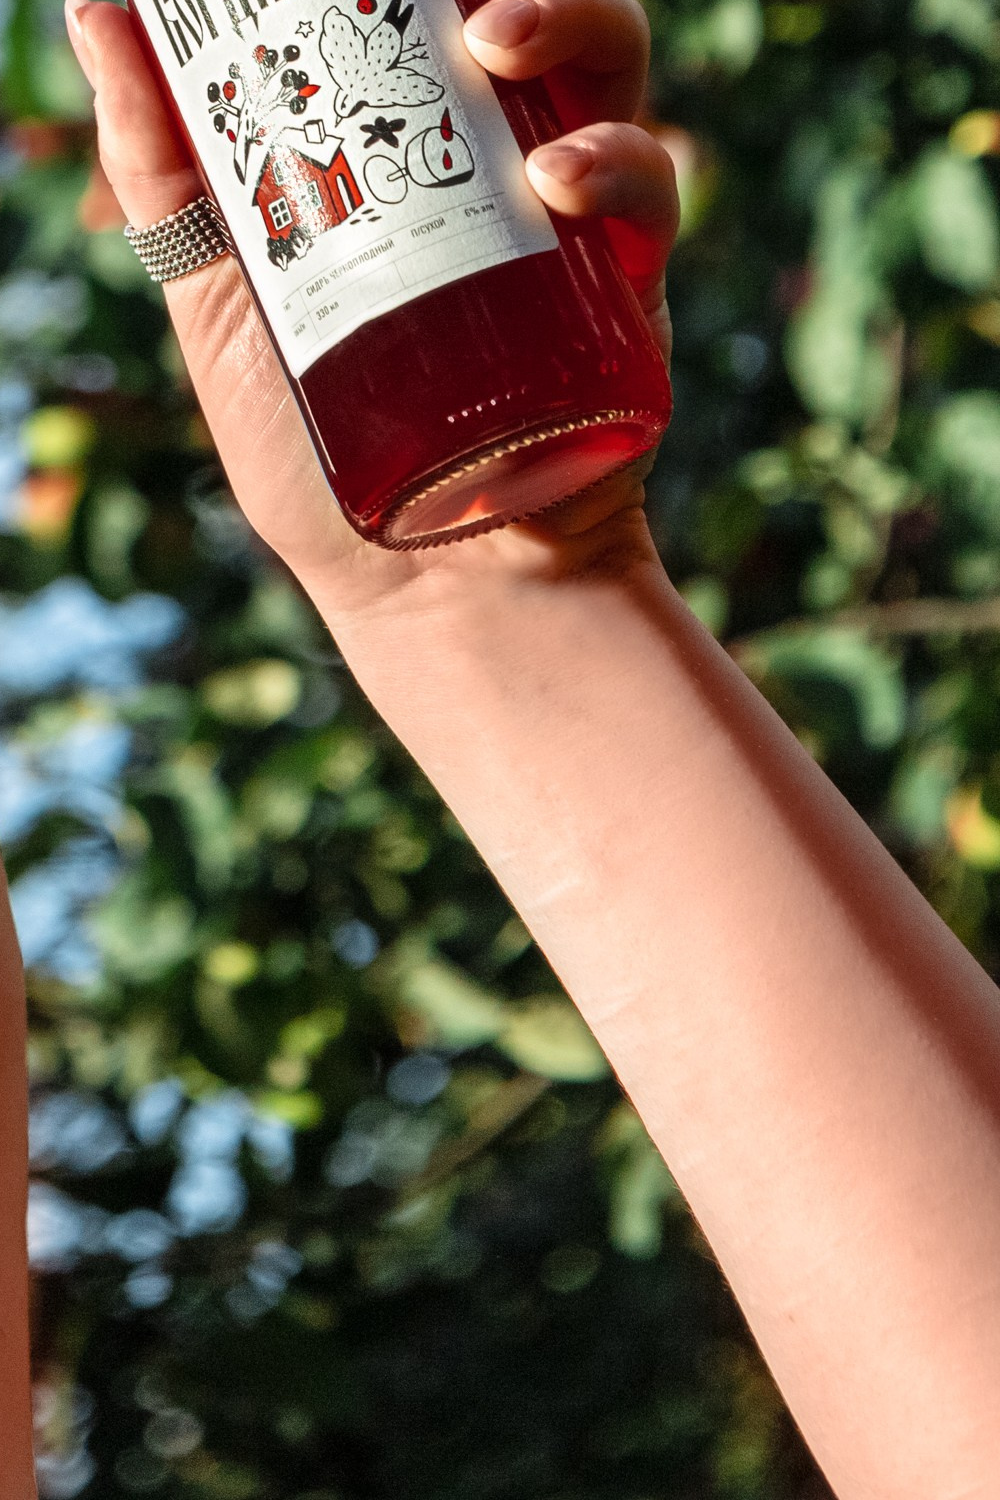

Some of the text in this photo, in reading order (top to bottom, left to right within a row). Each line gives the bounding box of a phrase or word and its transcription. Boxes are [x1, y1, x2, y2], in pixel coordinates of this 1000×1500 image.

[410, 217, 447, 239] П/СУХОЙ
[464, 205, 480, 218] 6%
[316, 305, 330, 321] 330
